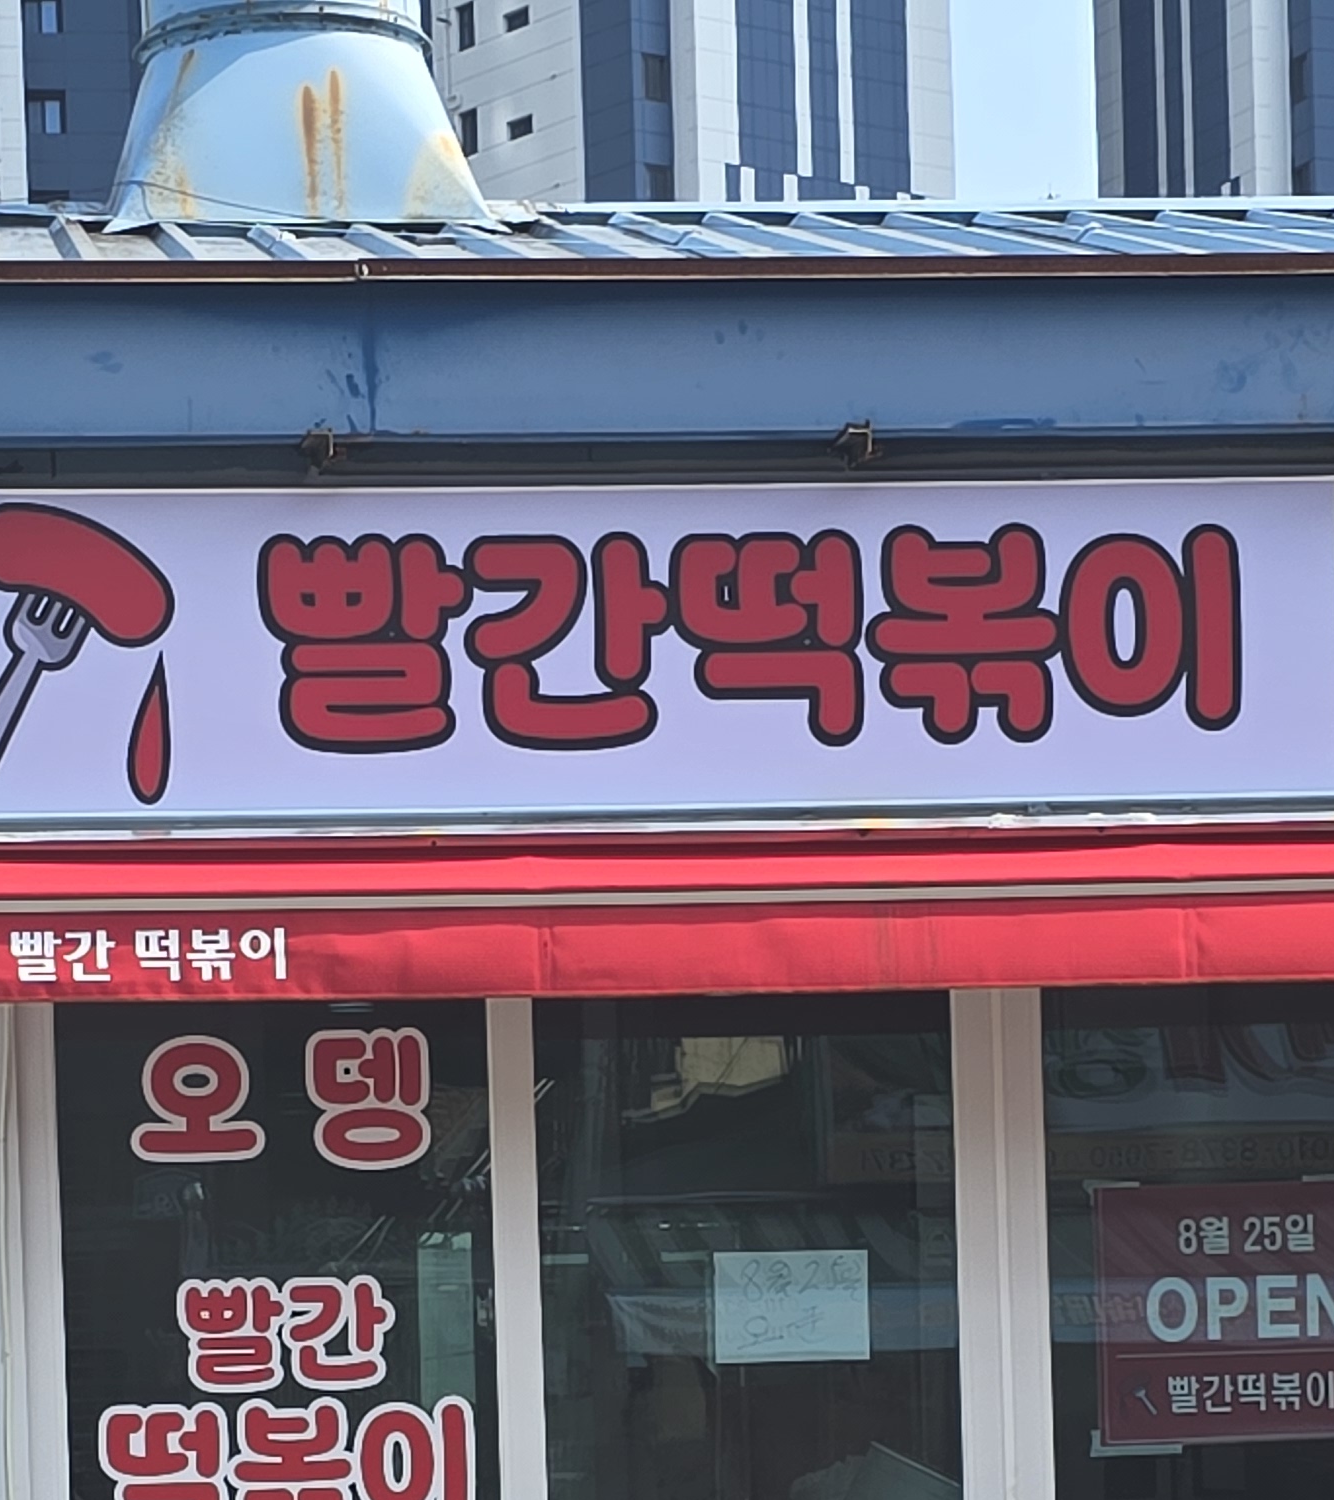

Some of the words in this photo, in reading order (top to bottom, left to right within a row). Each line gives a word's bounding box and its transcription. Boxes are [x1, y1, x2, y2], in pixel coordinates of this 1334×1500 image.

[258, 522, 1244, 753] 빨간떡볶이
[10, 929, 116, 982] 빨간
[135, 927, 287, 982] 떡볶이
[1178, 1216, 1230, 1255] 8월
[1243, 1213, 1316, 1253] 25일
[177, 1275, 395, 1393] 빨간
[1167, 1370, 1334, 1414] 빨간떡볶이
